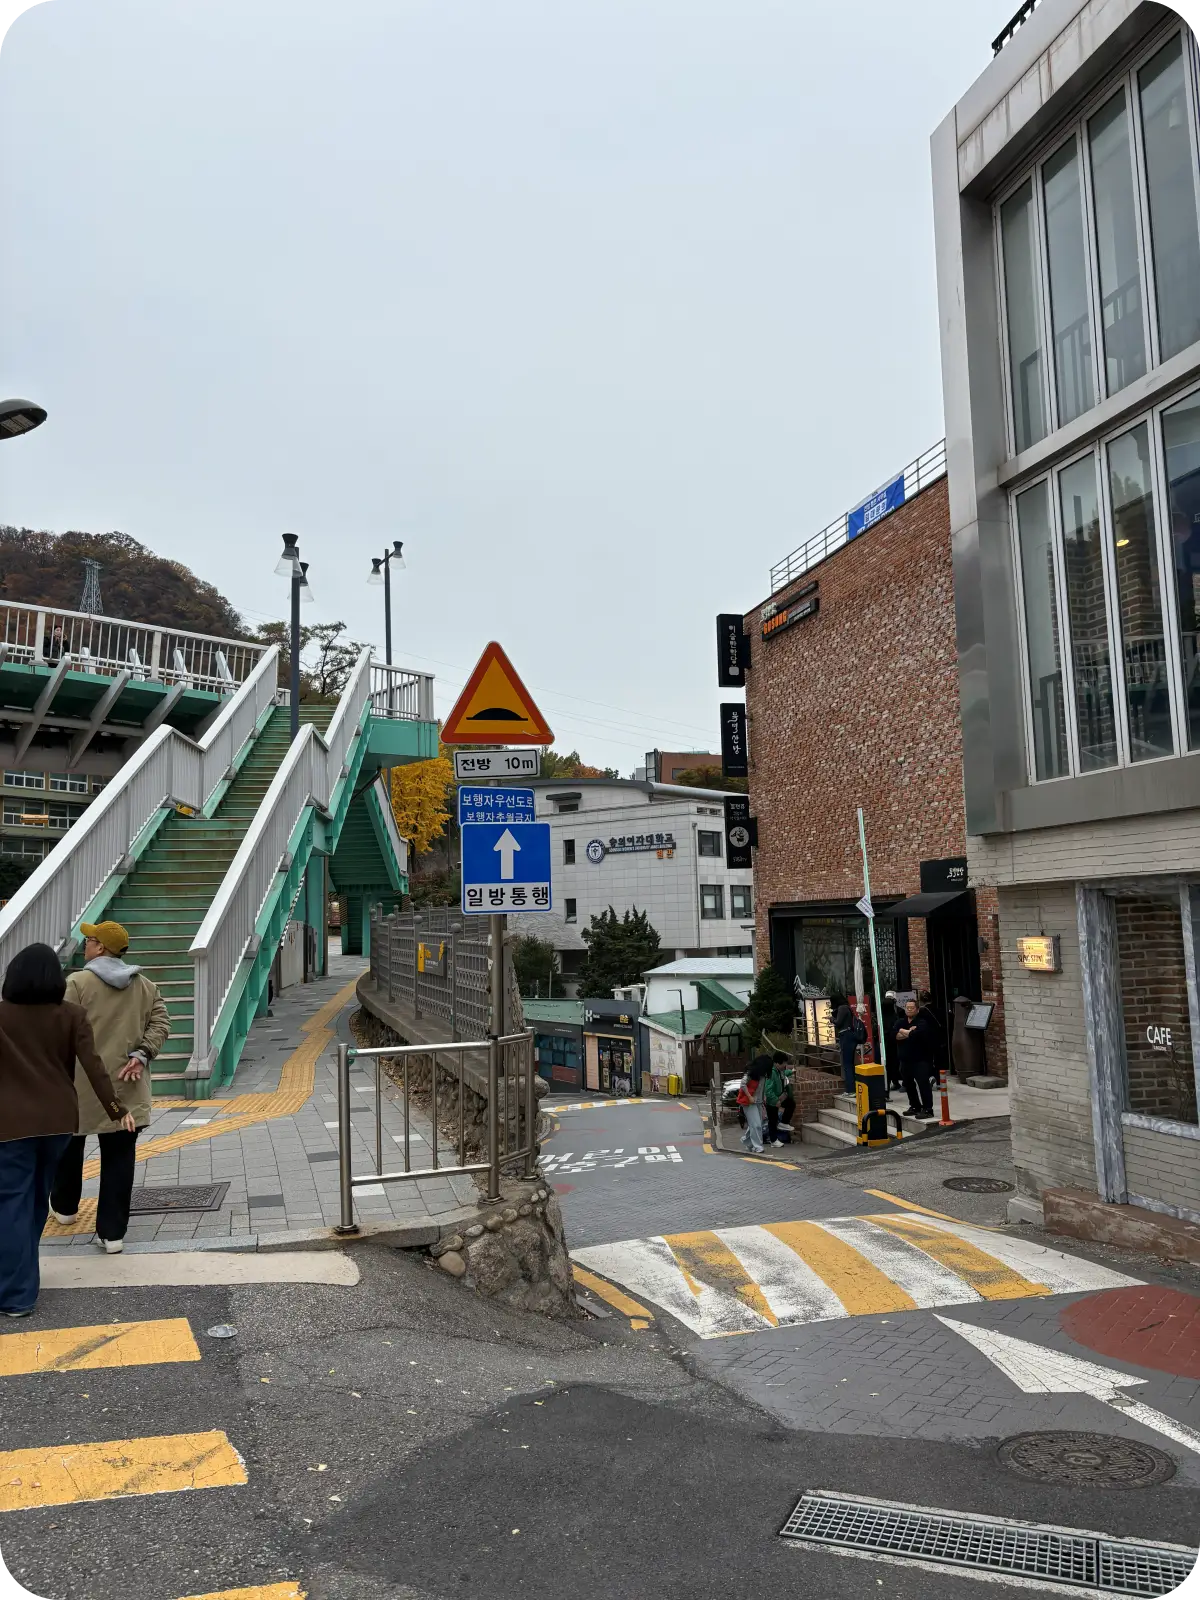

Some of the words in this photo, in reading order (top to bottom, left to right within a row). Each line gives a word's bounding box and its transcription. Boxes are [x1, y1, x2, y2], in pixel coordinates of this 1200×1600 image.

[460, 757, 491, 771] 전방
[504, 756, 534, 770] 10m
[461, 793, 534, 809] 보행자우선도로
[608, 832, 674, 848] 숭의여자대학교
[466, 886, 549, 907] 일방통행
[1146, 1025, 1172, 1046] CAFE
